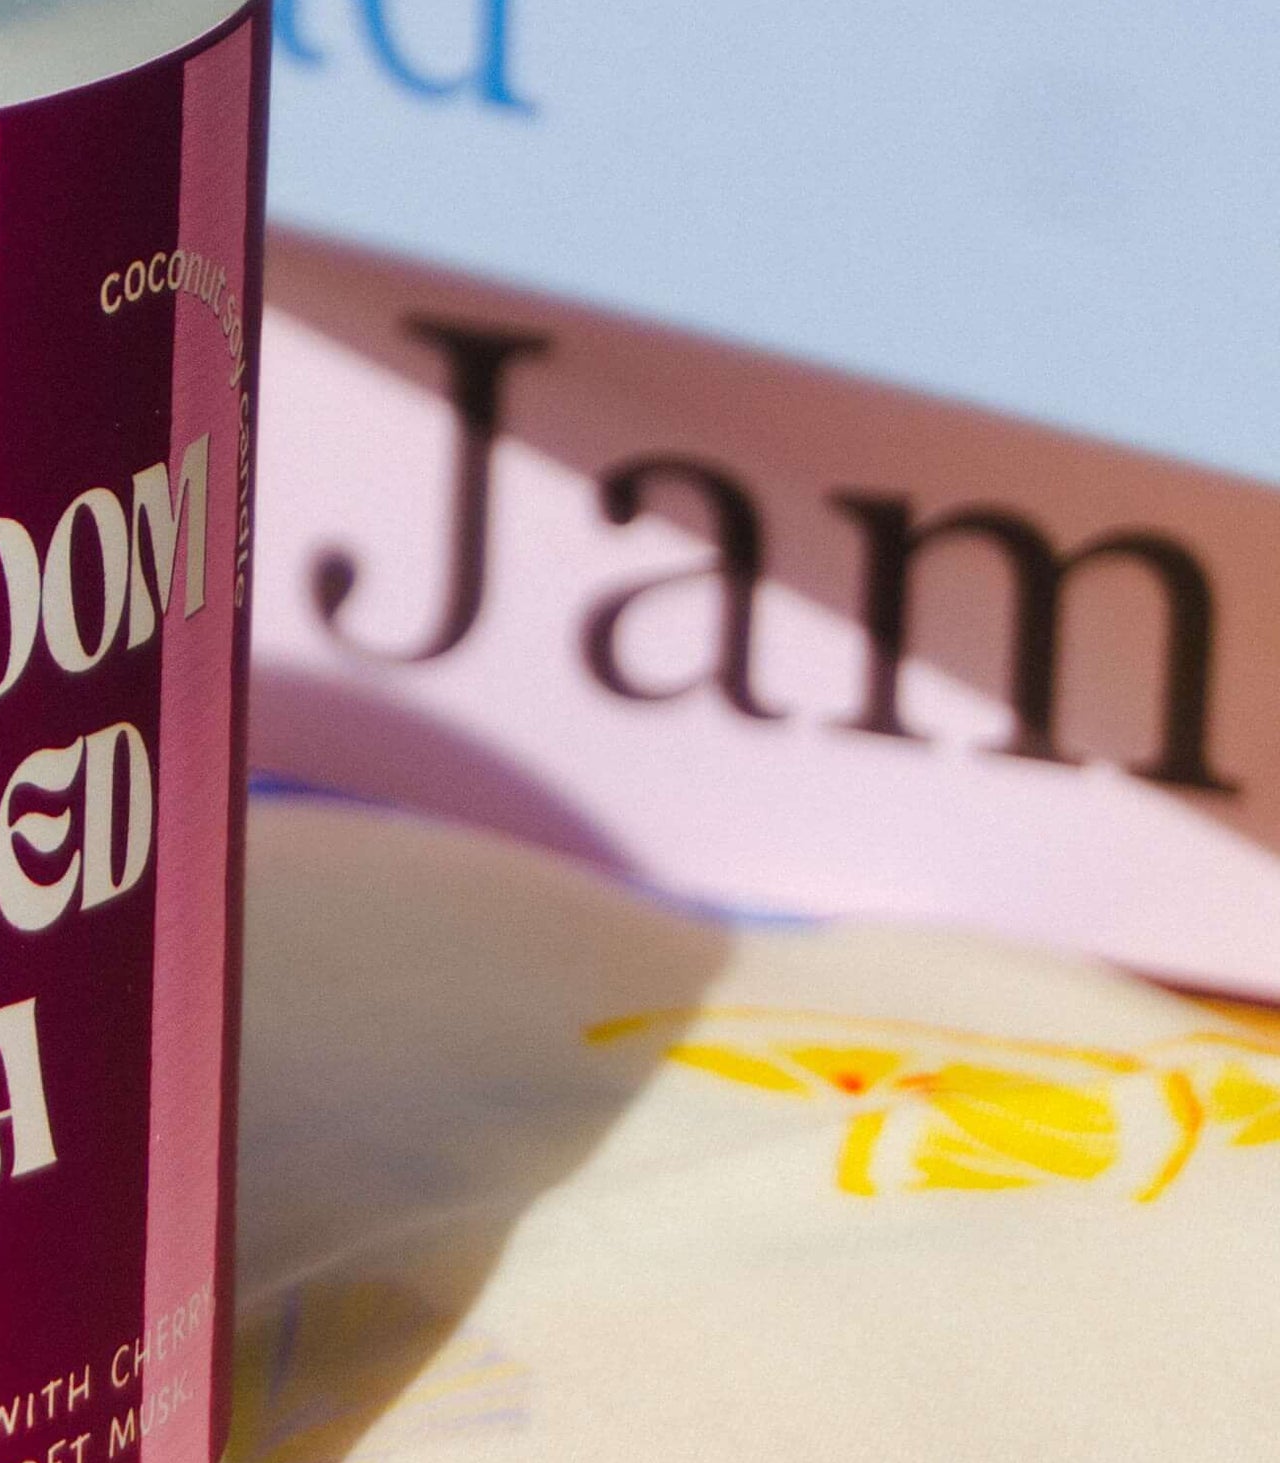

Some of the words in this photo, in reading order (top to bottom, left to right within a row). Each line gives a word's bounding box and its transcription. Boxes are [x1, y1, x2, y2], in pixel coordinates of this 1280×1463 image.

[100, 249, 228, 315] coconut
[224, 294, 247, 390] soy
[305, 310, 1241, 797] Jam
